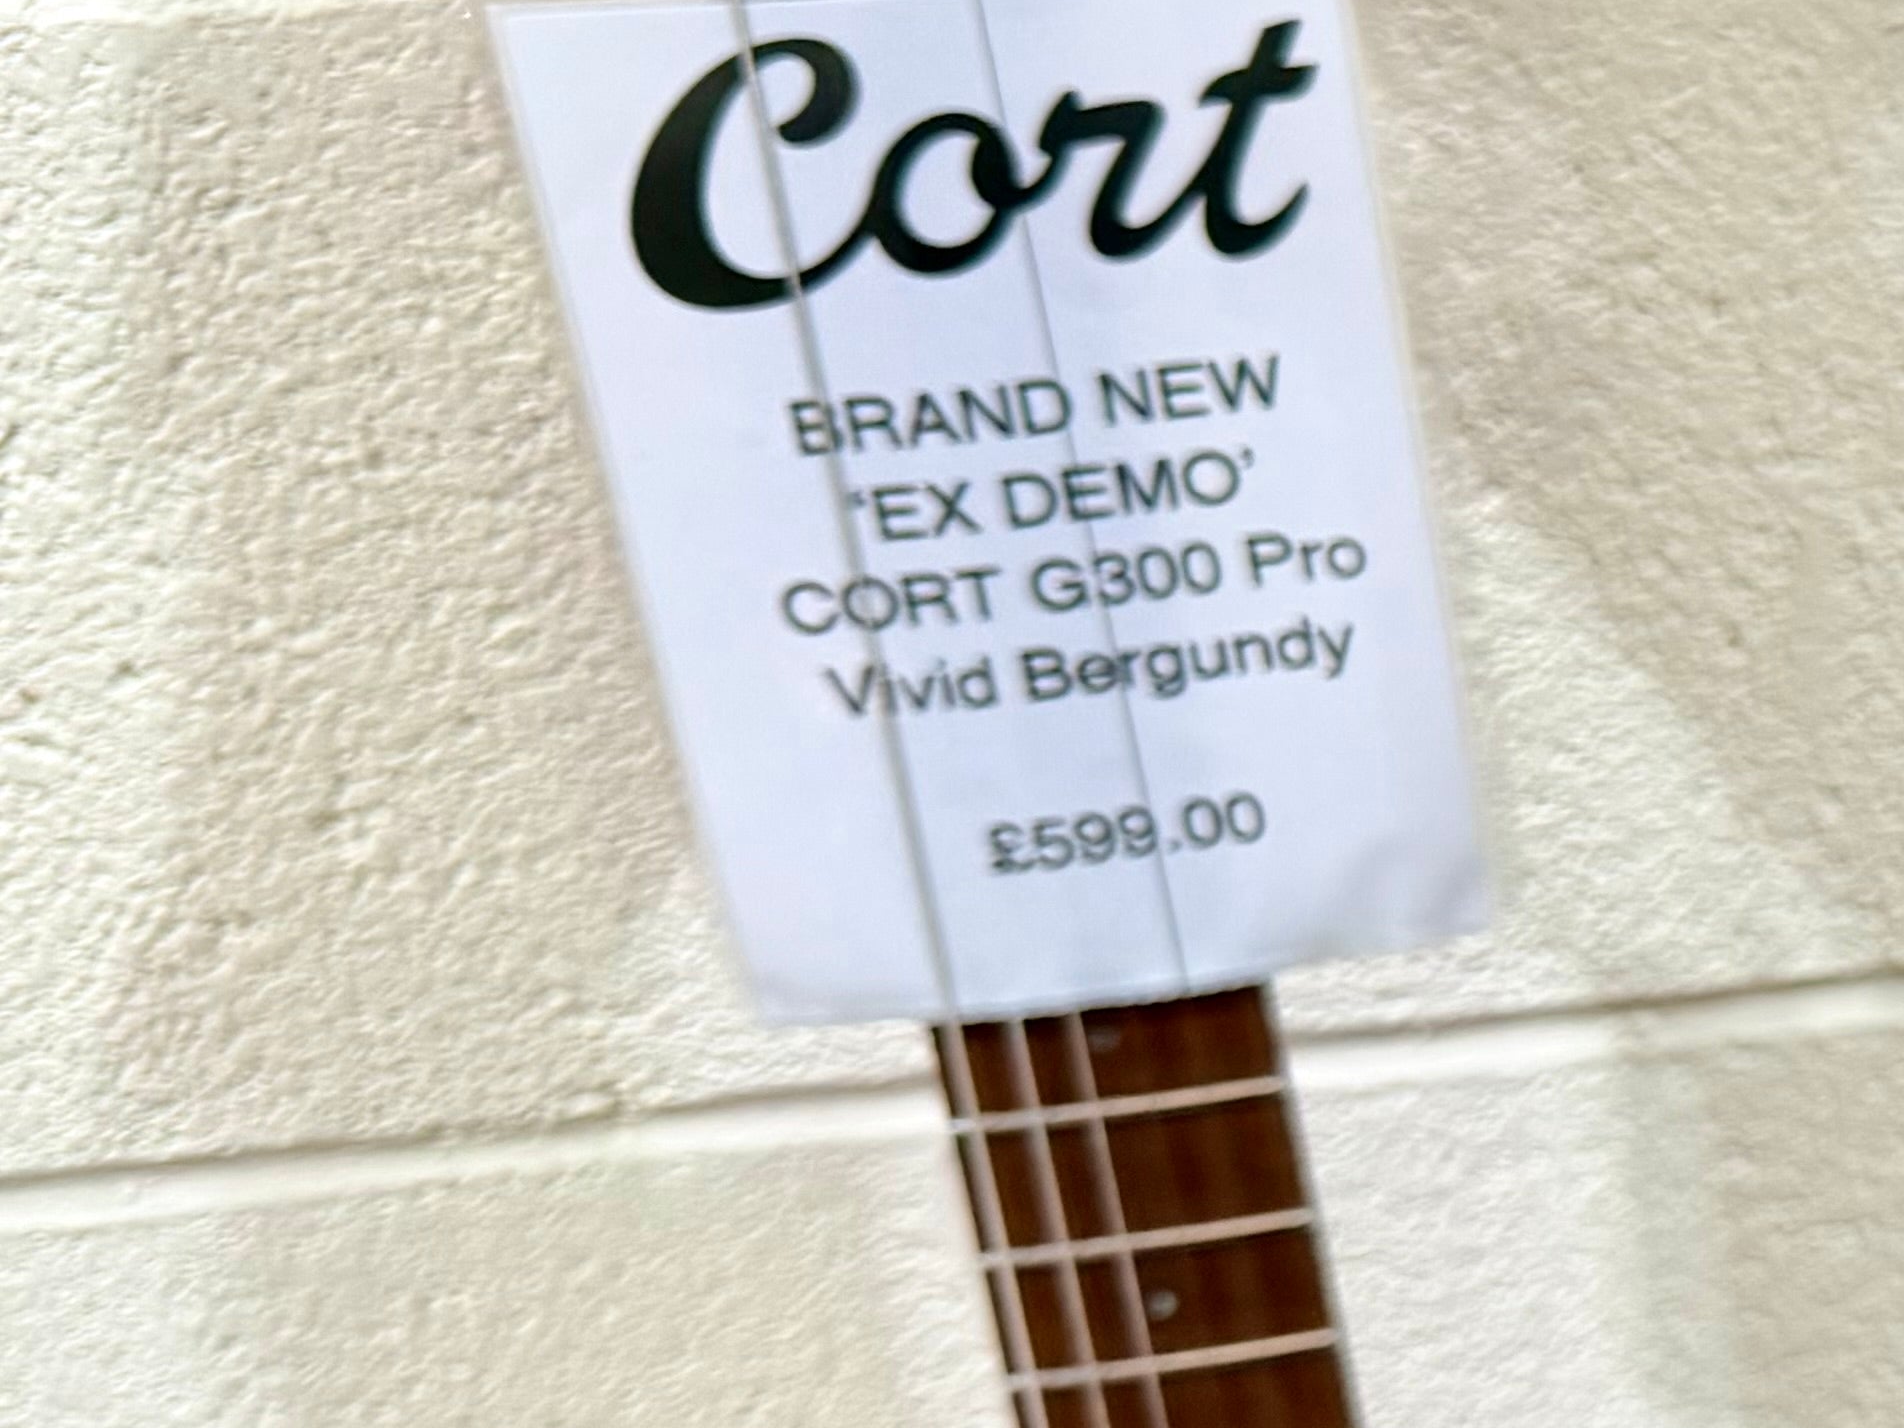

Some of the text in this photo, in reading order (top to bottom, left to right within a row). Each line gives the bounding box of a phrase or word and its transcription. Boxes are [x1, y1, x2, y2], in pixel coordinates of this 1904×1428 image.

[629, 18, 1320, 314] Cort
[790, 352, 1282, 457] BRAND NEW
[781, 531, 1369, 635] CORT G300 Pro
[825, 616, 1355, 717] Vivid Bergundy
[987, 791, 1268, 875] £599.00
